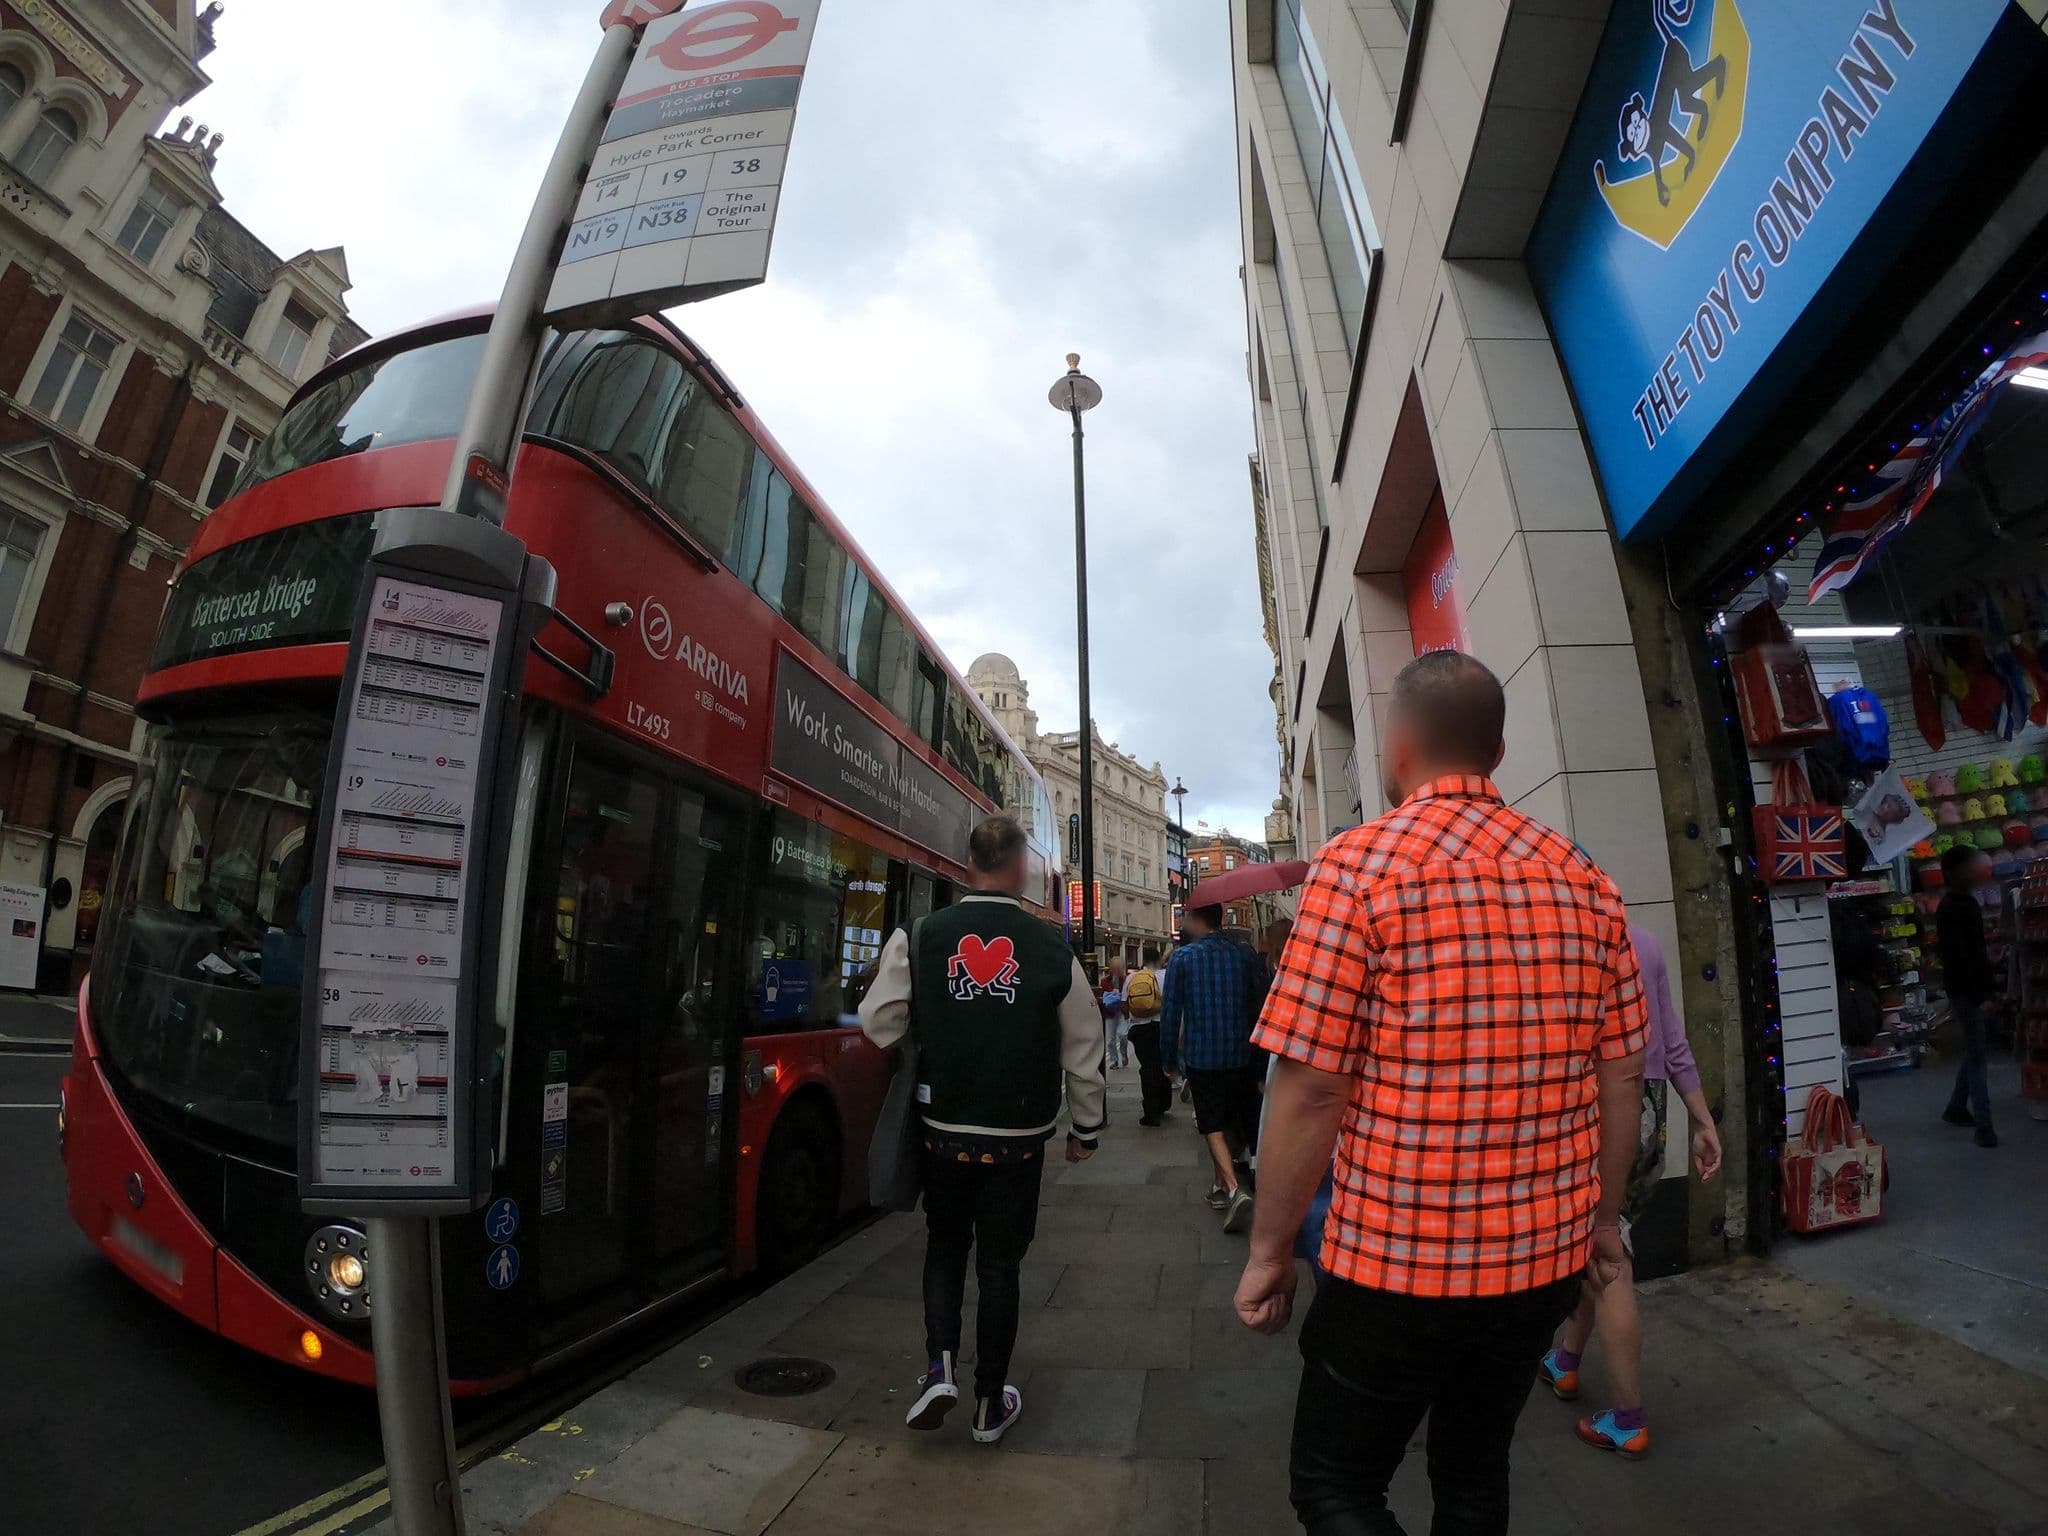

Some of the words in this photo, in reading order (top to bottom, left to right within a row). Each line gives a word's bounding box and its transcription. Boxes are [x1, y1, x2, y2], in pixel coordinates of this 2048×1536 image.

[669, 80, 696, 91] BUS
[703, 72, 740, 84] STOP
[658, 86, 743, 110] Trocadero
[661, 100, 731, 120] Haymarket
[663, 126, 712, 140] towards
[609, 147, 652, 167] Hyde
[657, 140, 693, 155] Park
[700, 129, 764, 146] Corner
[730, 159, 761, 175] 38
[661, 169, 687, 186] 19
[597, 184, 619, 202] 14
[725, 192, 753, 202] The
[649, 203, 670, 212] Night
[671, 200, 685, 208] Bus
[707, 203, 767, 217] Original
[638, 208, 688, 231] N38
[717, 217, 751, 228] Tour
[1633, 354, 1691, 450] THE
[1676, 268, 1741, 384] TOY
[1733, 0, 1917, 303] COMPANY
[572, 223, 619, 248] N19
[191, 589, 261, 628] Battersea
[262, 570, 316, 618] Bridge
[386, 588, 400, 601] 14
[209, 626, 247, 649] SOUTH
[249, 621, 276, 641] SIDE
[674, 634, 749, 706] ARRIVA
[714, 702, 747, 730] company
[786, 688, 830, 748] Work
[833, 724, 885, 783] Smarter.
[888, 762, 909, 798] Not
[910, 777, 941, 818] Harder
[348, 775, 364, 788] 19
[771, 836, 785, 864] 19
[787, 840, 825, 868] Battersea
[1281, 889, 1293, 897] 40
[322, 988, 340, 1001] 38
